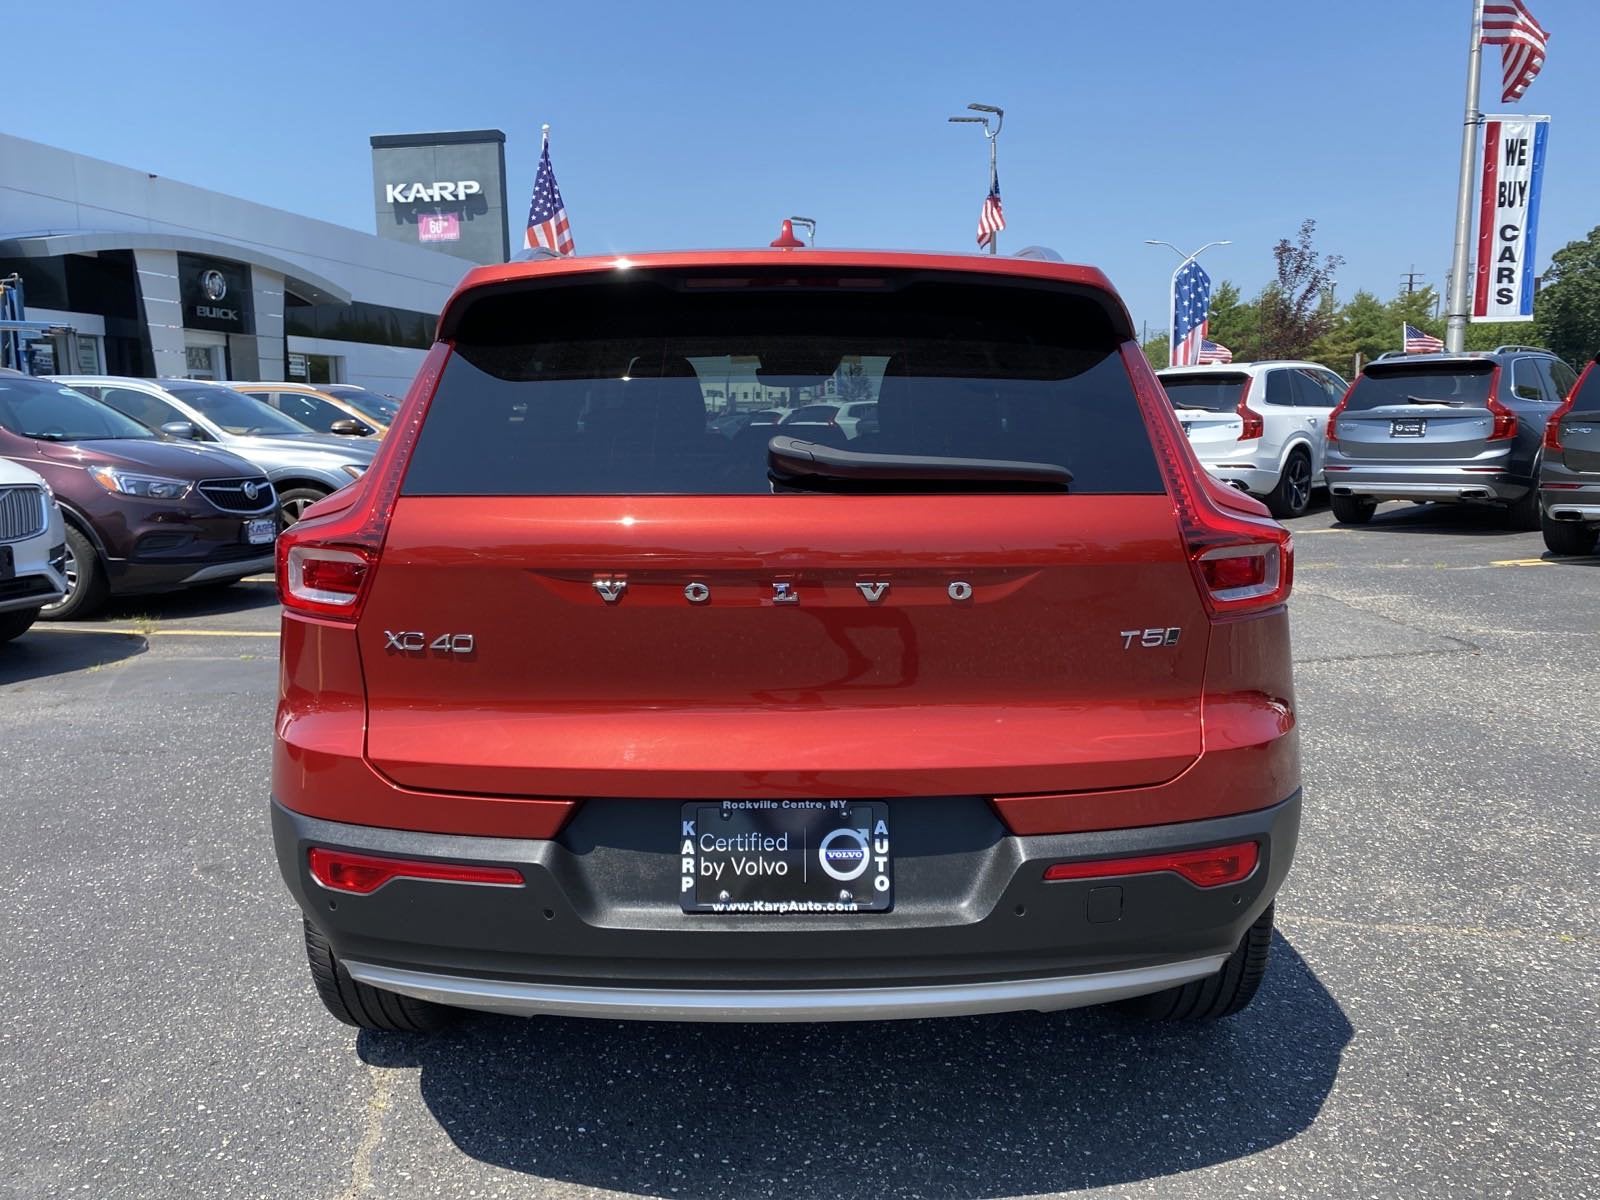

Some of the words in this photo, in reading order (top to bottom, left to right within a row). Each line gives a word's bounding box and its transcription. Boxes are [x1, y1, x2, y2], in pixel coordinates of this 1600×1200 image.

[1505, 138, 1529, 167] WE
[385, 180, 481, 203] KARP
[1497, 180, 1528, 208] BUY
[1495, 224, 1520, 305] CARS
[196, 304, 238, 321] BUICK
[592, 580, 973, 603] VOLVO
[722, 800, 779, 810] Rockville
[781, 800, 826, 810] Centre,
[830, 800, 847, 809] NY
[700, 832, 788, 852] Certified
[681, 820, 696, 893] KARP
[874, 819, 890, 892] AUTO
[701, 856, 725, 881] by
[731, 856, 788, 876] Volvo
[712, 901, 858, 912] www.KarpAuto.com
